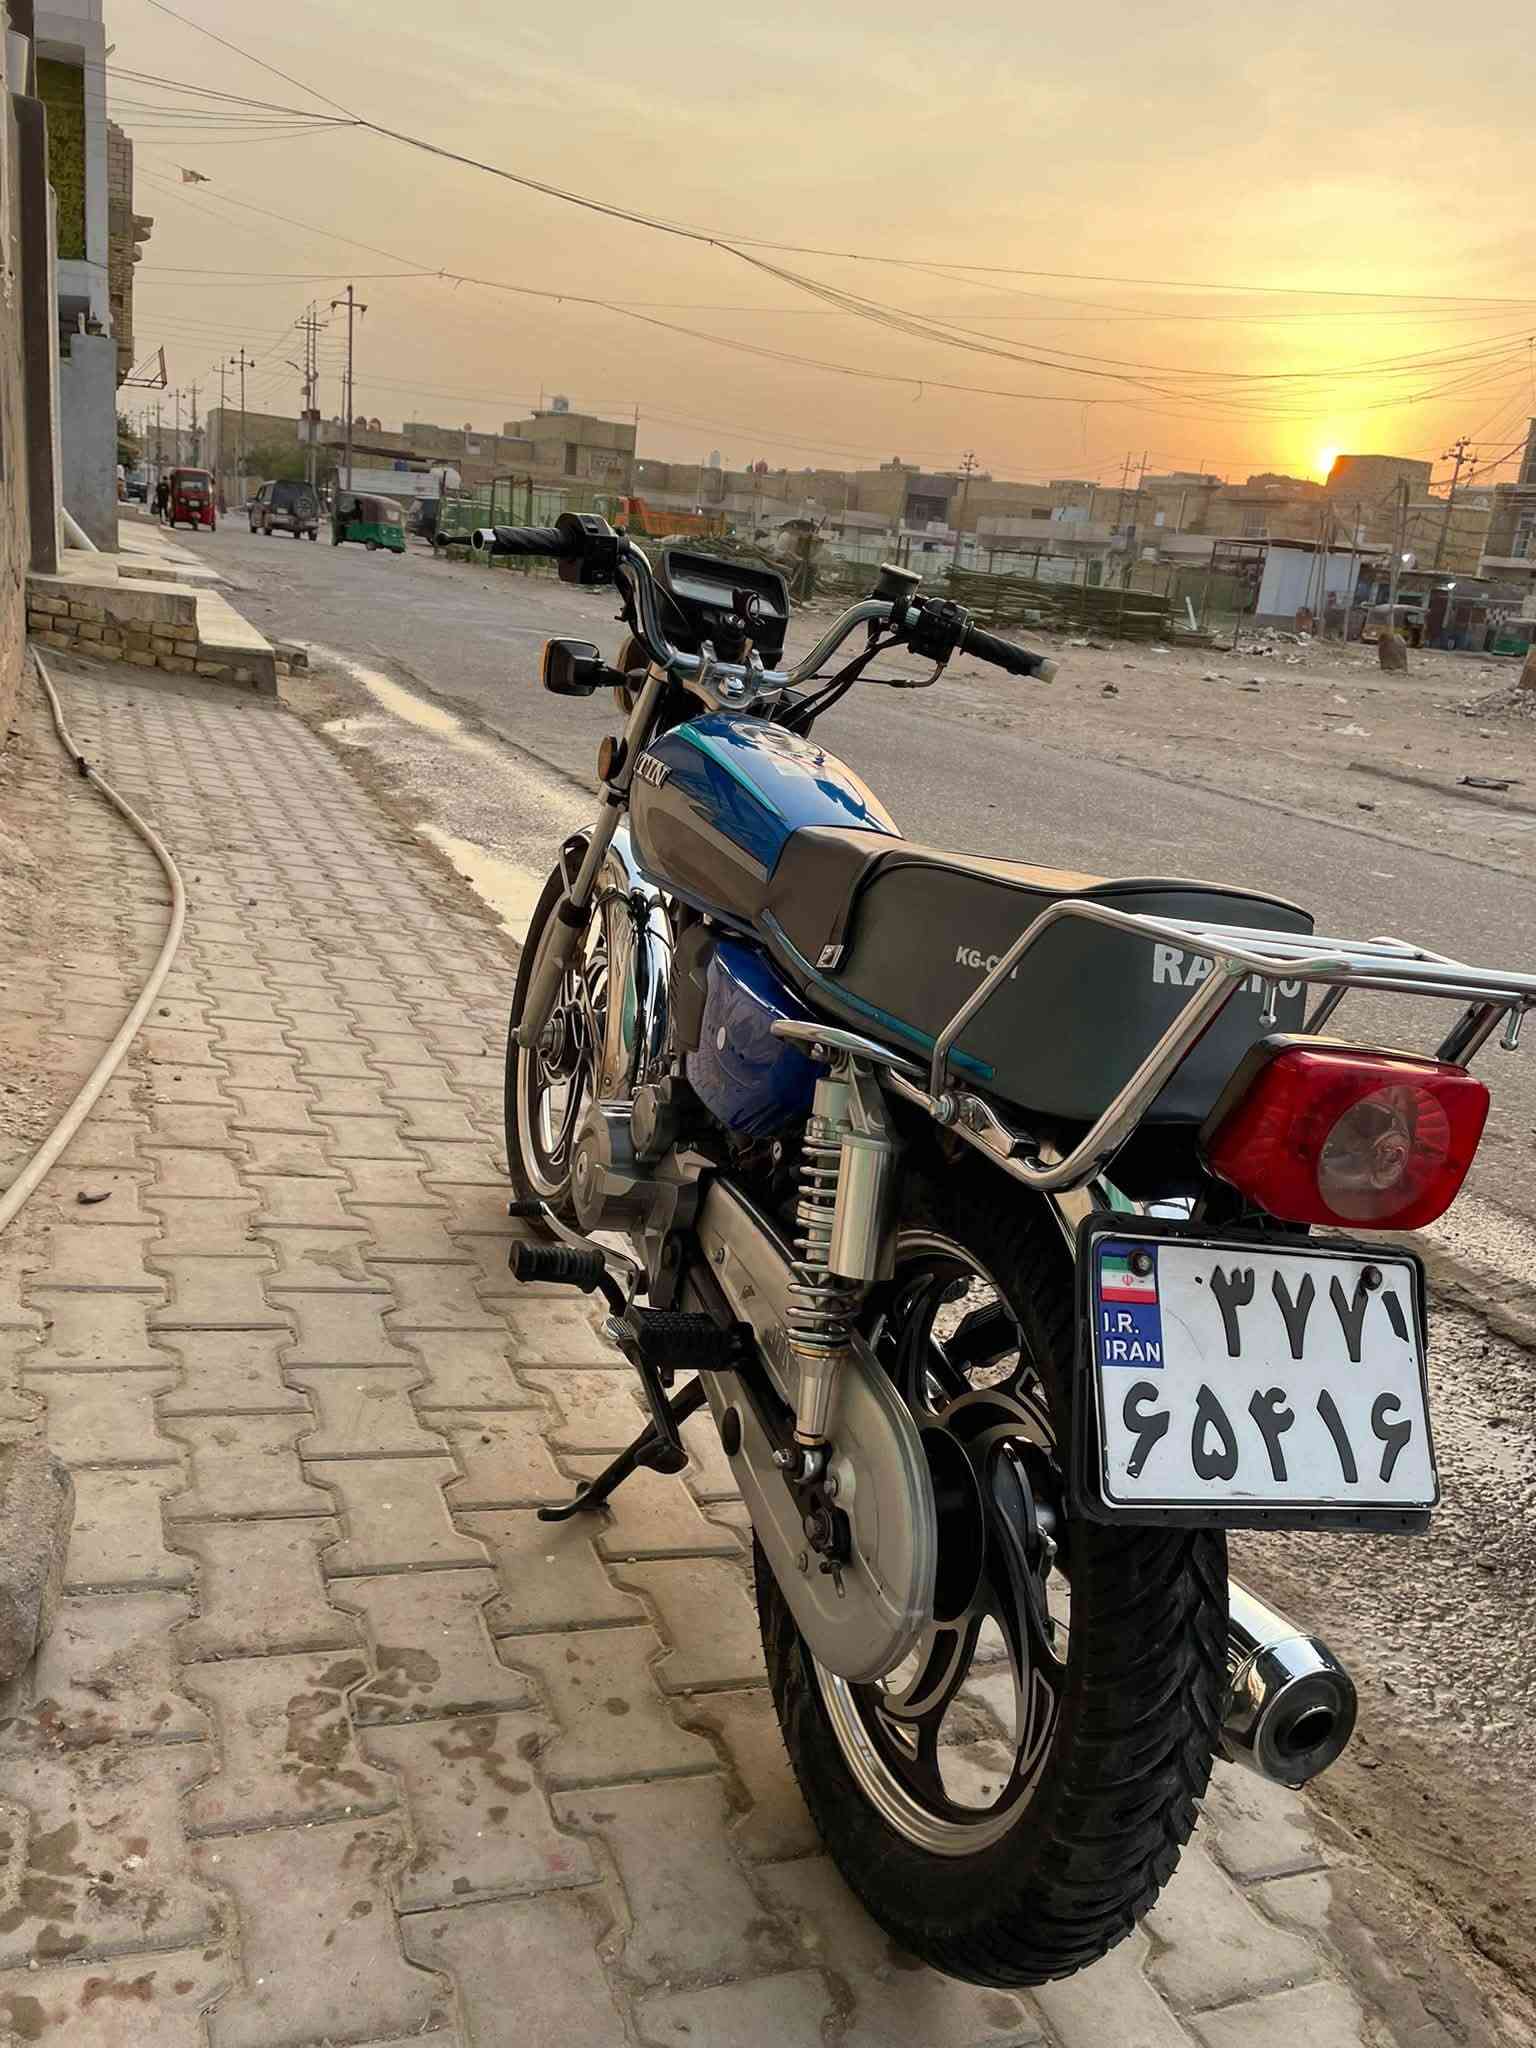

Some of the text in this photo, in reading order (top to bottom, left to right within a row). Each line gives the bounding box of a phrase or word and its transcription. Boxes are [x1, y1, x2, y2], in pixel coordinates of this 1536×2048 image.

[1103, 1311, 1139, 1334] I.R.
[1105, 1339, 1160, 1363] IRAN
[1123, 1381, 1412, 1483] ۶۵۴۱۶
